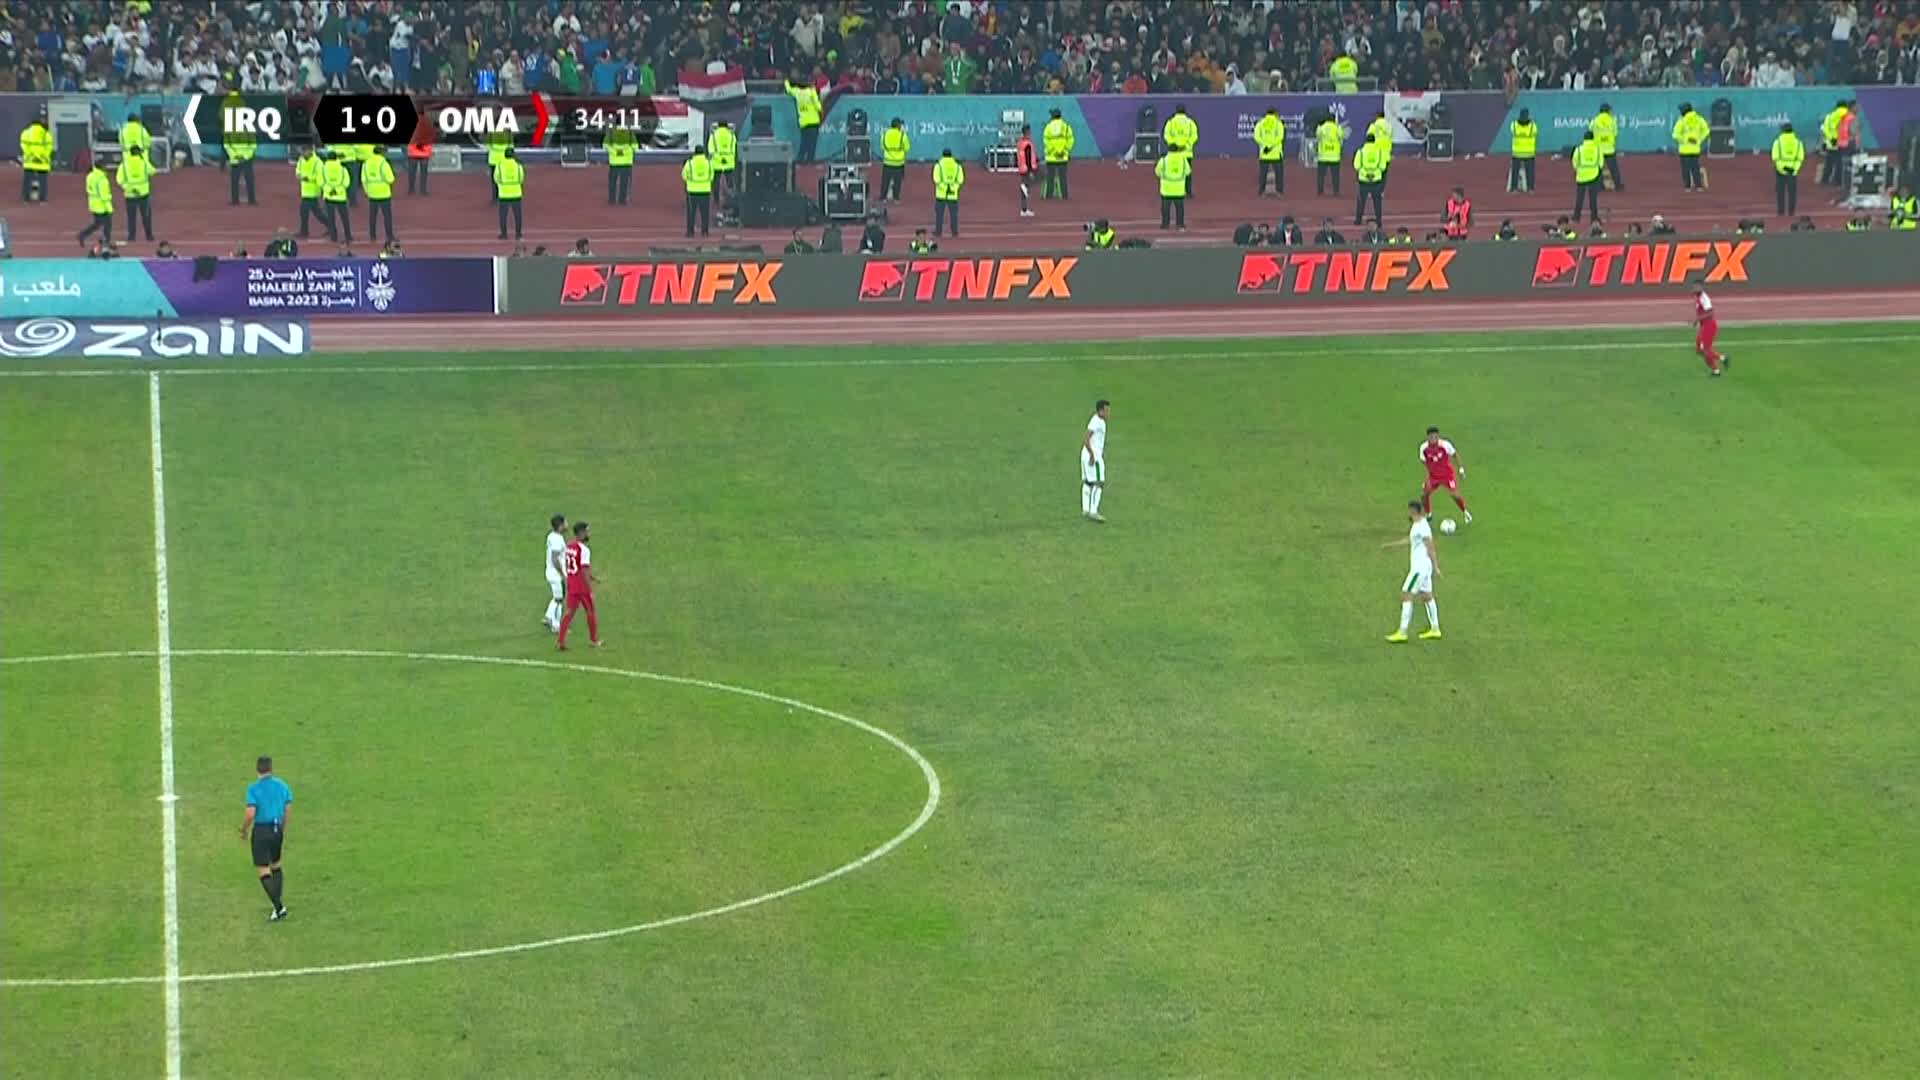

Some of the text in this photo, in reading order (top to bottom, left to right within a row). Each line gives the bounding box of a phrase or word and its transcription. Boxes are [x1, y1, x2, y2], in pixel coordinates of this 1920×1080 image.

[248, 268, 263, 280] 25
[911, 257, 1078, 300] TNFX
[1290, 249, 1456, 293] TNFX
[1581, 240, 1756, 285] TNFX
[13, 274, 81, 303] ملعب
[248, 281, 355, 293] KHALEEJI ZAIN 25
[248, 296, 285, 307] BASRA
[287, 295, 319, 306] 2023
[614, 263, 782, 305] TNFX
